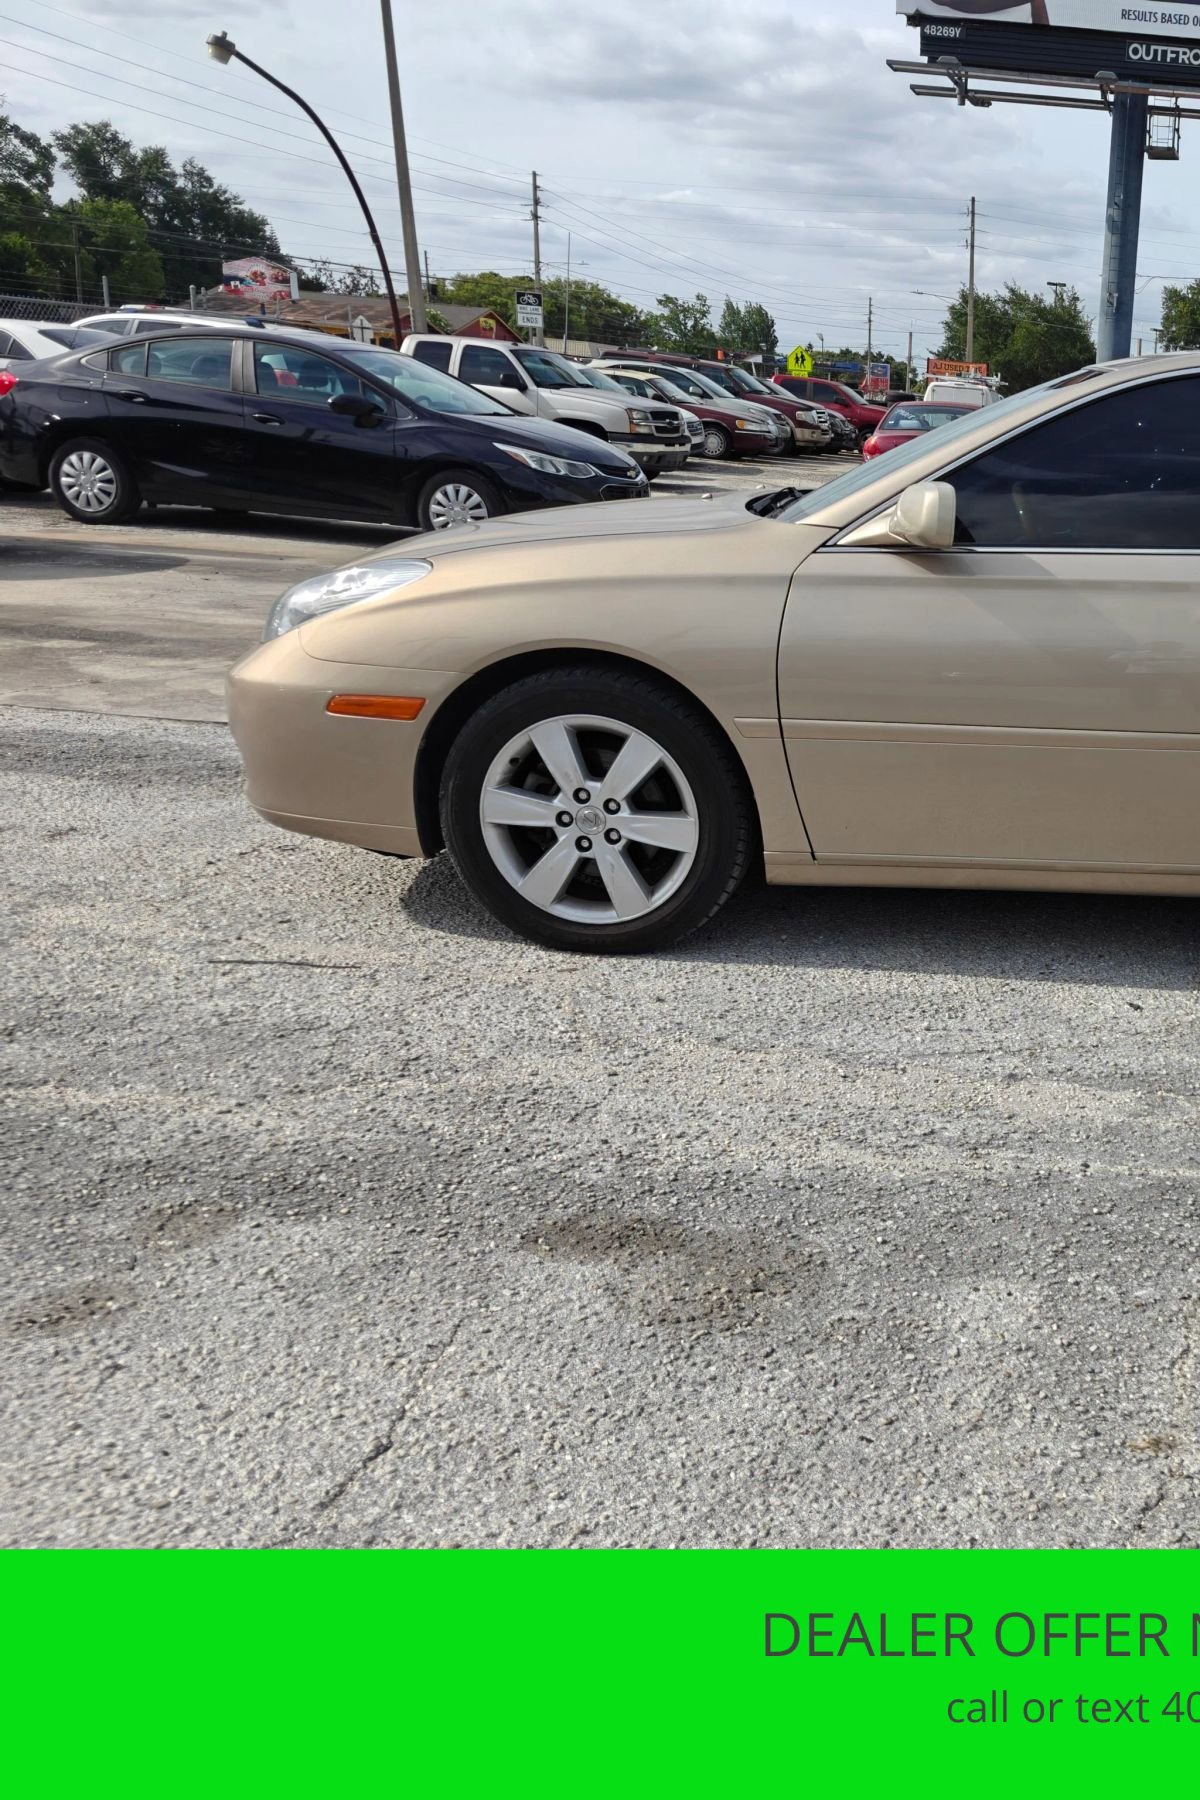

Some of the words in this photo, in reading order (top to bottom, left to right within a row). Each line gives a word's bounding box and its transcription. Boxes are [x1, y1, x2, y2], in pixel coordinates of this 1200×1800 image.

[1121, 9, 1158, 23] RESULTS
[1160, 13, 1190, 26] BASED
[924, 24, 961, 37] 48269Y
[522, 316, 538, 324] ENDS
[944, 363, 963, 372] USED
